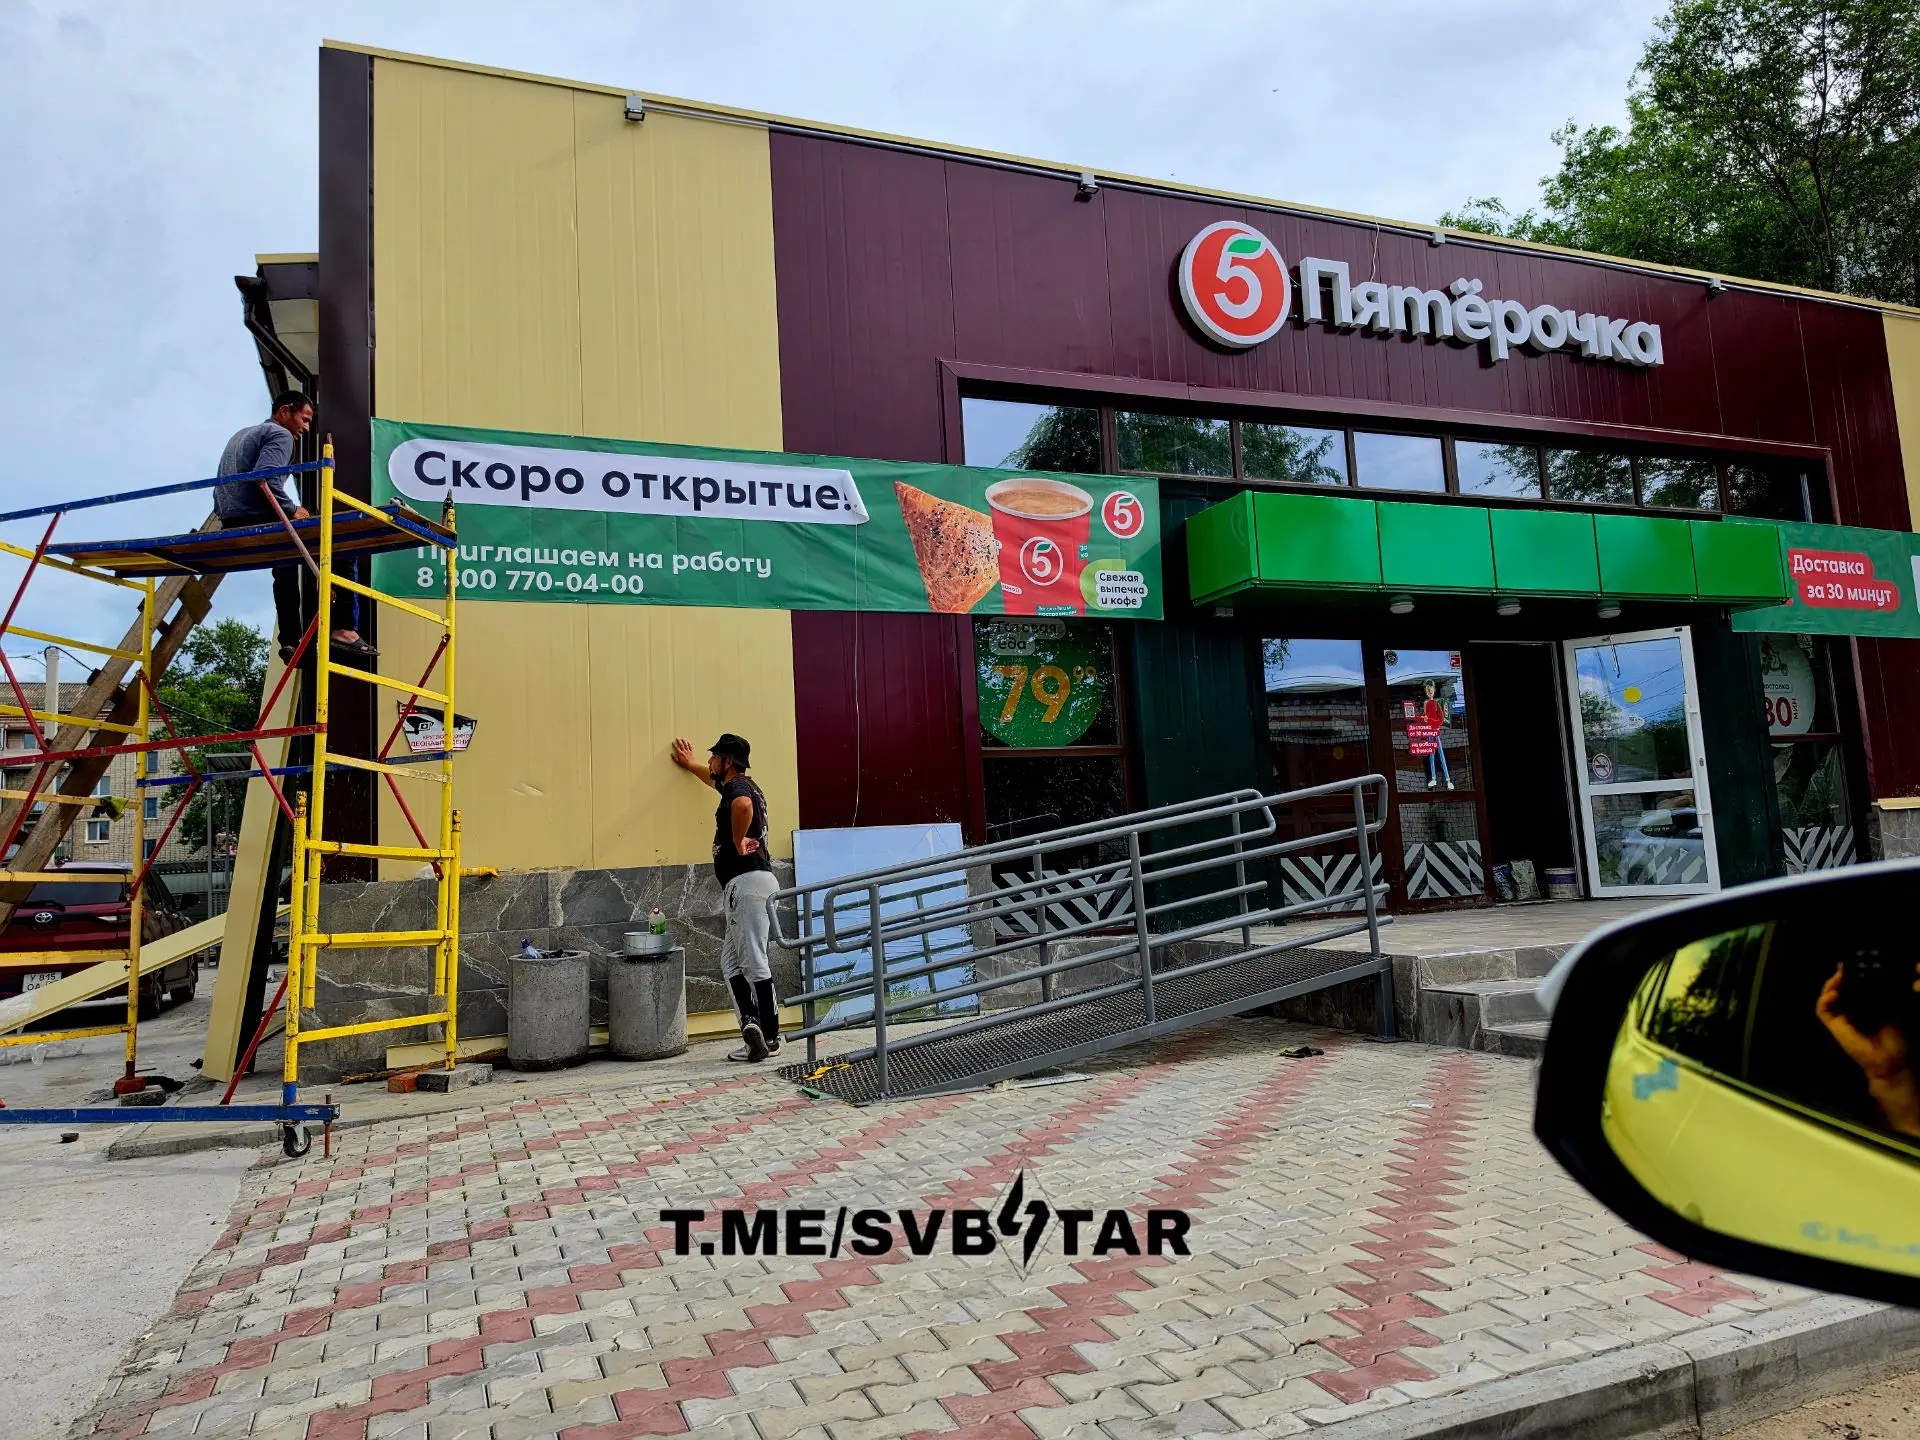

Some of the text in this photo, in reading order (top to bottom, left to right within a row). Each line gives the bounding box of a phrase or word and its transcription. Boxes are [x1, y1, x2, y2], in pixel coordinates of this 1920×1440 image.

[1299, 256, 1665, 367] Пятёрочка
[414, 451, 585, 501] Скоро
[628, 552, 663, 569] на
[672, 550, 772, 578] работу
[1793, 554, 1865, 576] Доставка
[416, 567, 434, 588] 8
[505, 570, 644, 594] 770-04-00
[1099, 572, 1139, 582] Свежая
[1100, 585, 1145, 595] выпечка
[1101, 595, 1137, 608] и кофе
[1807, 583, 1892, 607] за 30 минут
[997, 637, 1027, 650] еда
[992, 665, 1071, 723] 79
[39, 973, 56, 981] 815
